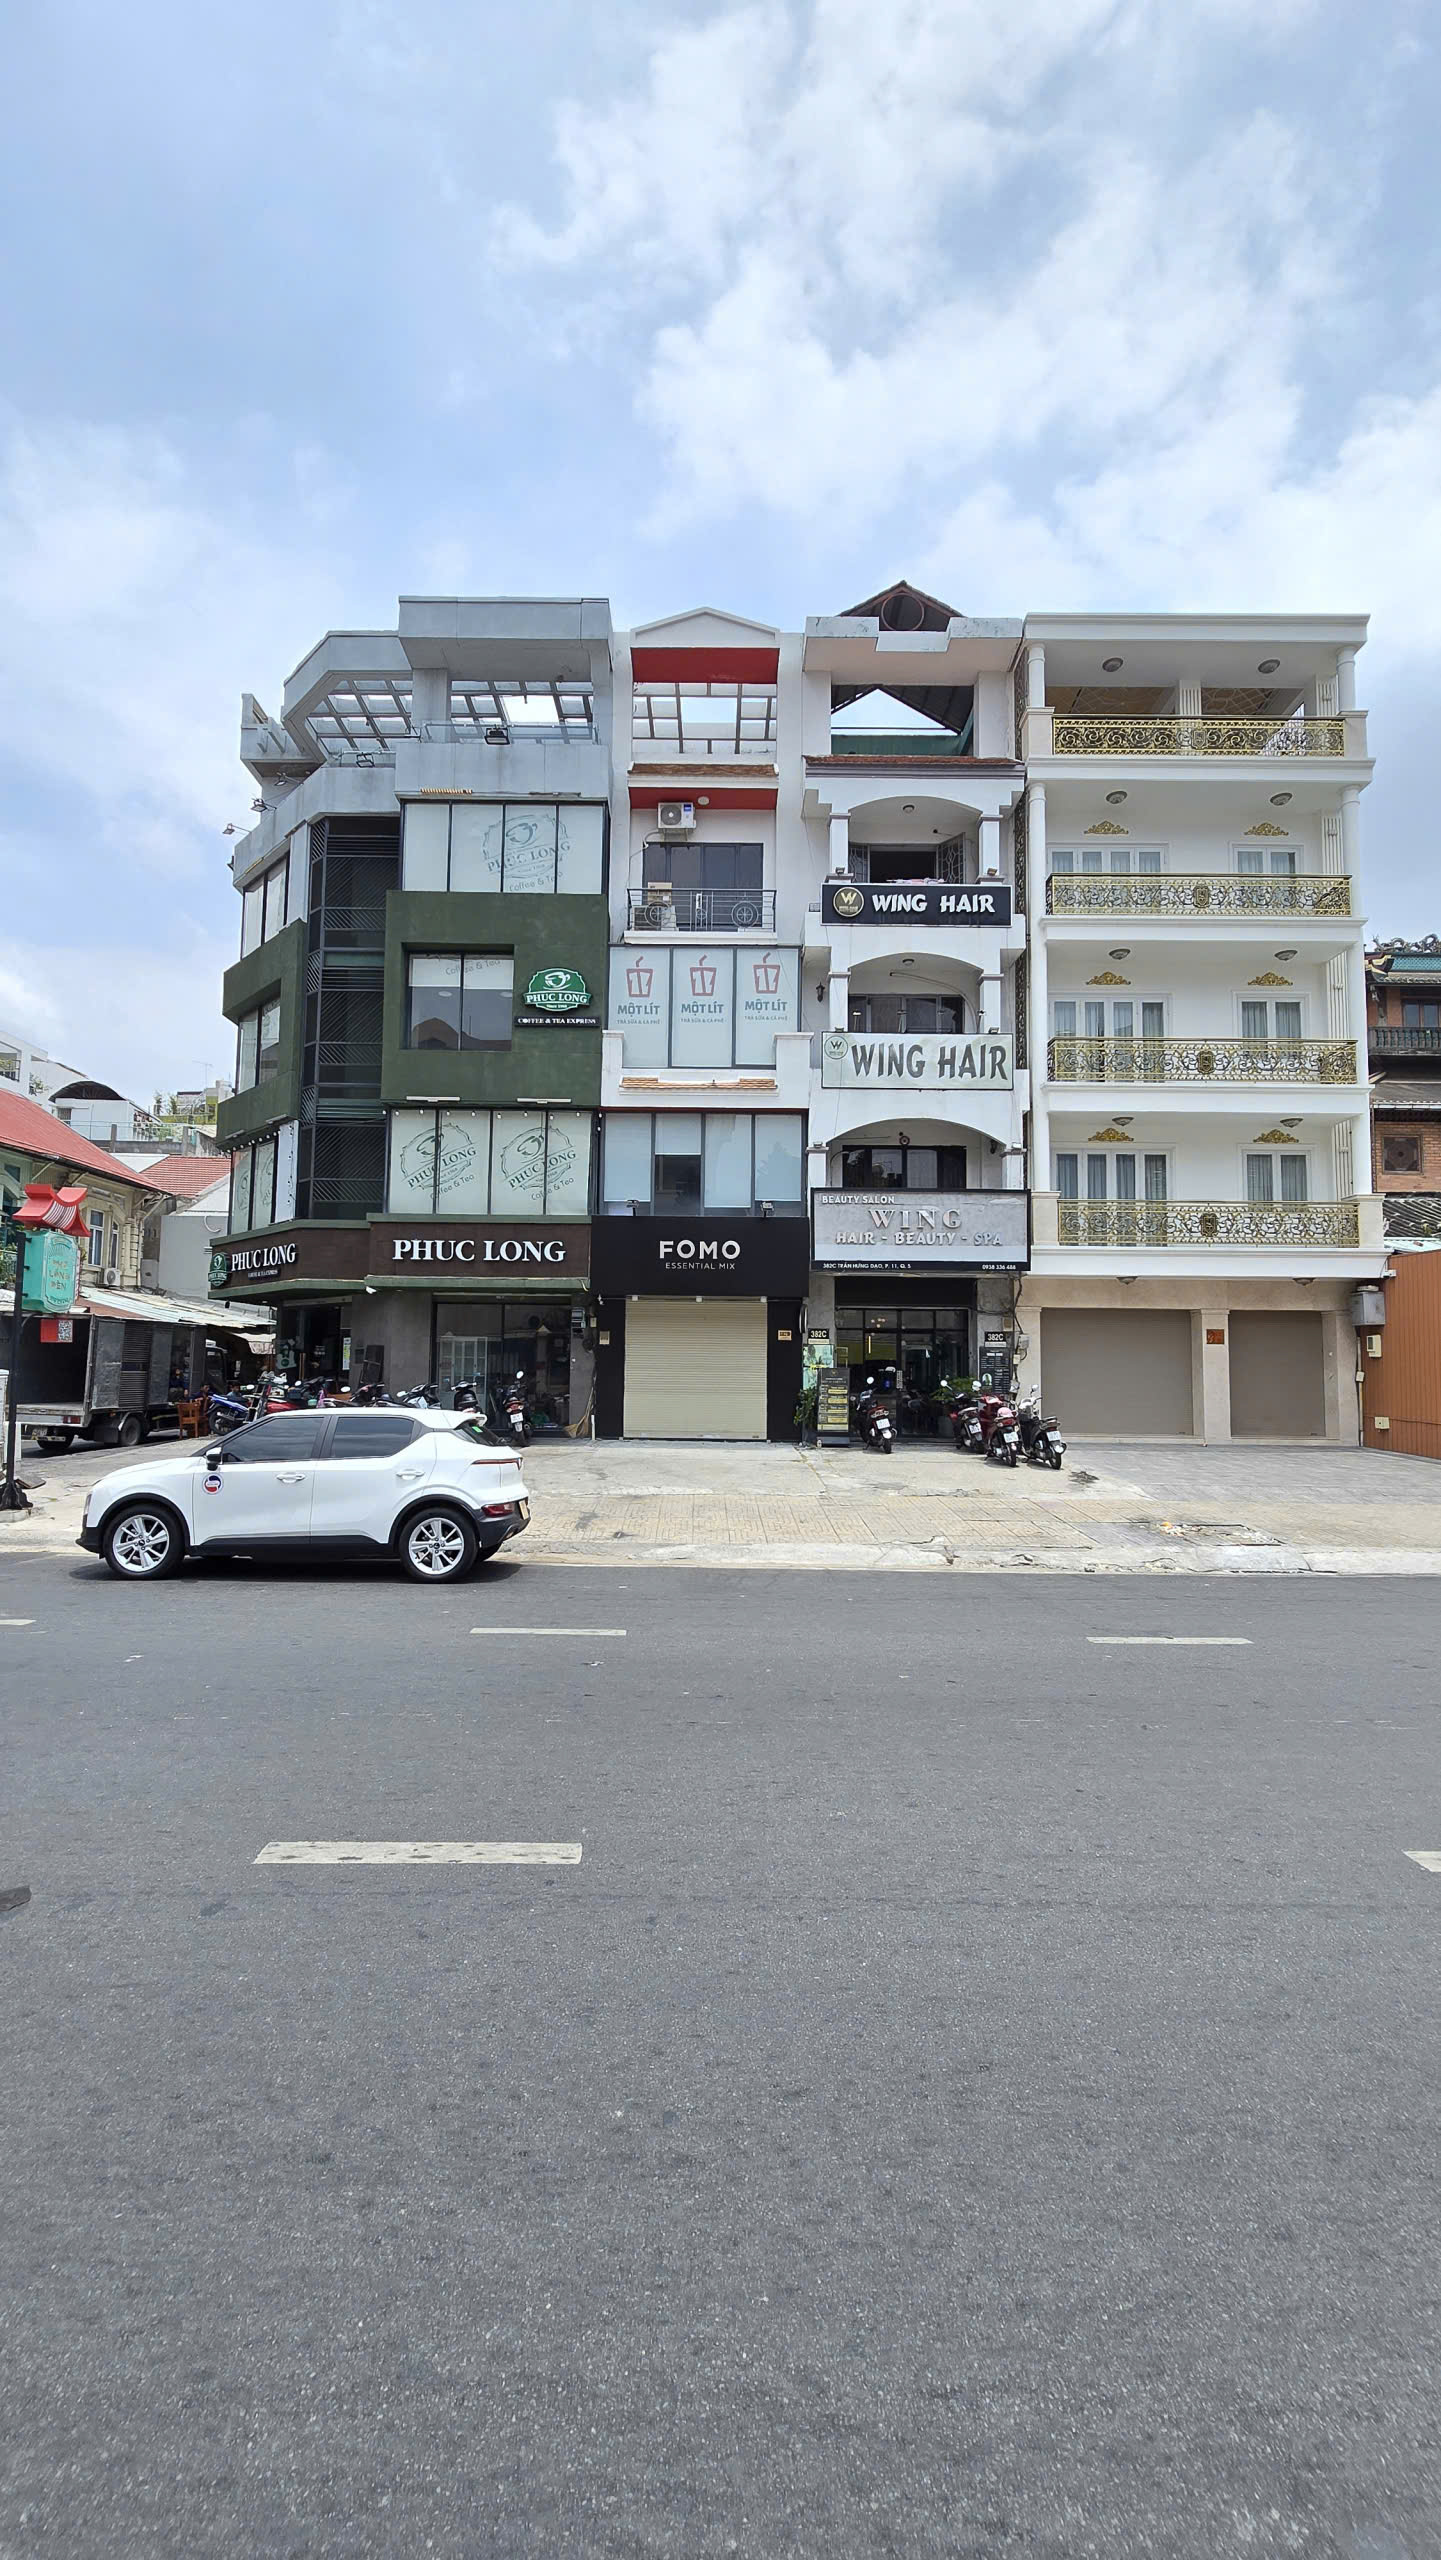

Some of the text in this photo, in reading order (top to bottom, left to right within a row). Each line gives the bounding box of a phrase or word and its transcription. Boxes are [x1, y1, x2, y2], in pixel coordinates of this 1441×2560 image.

[872, 894, 928, 912] WING
[940, 894, 996, 913] HAIR
[526, 994, 588, 1003] PHUC LONG
[681, 1000, 724, 1016] MỘT LÍT
[744, 998, 787, 1014] MỘT LÍT
[618, 1002, 660, 1017] MỘT LÍT
[851, 1042, 1008, 1080] WING HAIR
[442, 1147, 476, 1166] LONG
[508, 1164, 539, 1188] PHUC
[822, 1195, 895, 1204] BEAUTY SALON
[868, 1208, 962, 1229] WING
[836, 1232, 875, 1244] HAIR
[894, 1232, 956, 1245] BEAUTY
[974, 1234, 1002, 1246] SPA
[231, 1243, 296, 1271] PHUC LONG
[392, 1239, 566, 1262] PHUC LONG
[660, 1240, 740, 1259] FOMO
[810, 1330, 827, 1338] 382C
